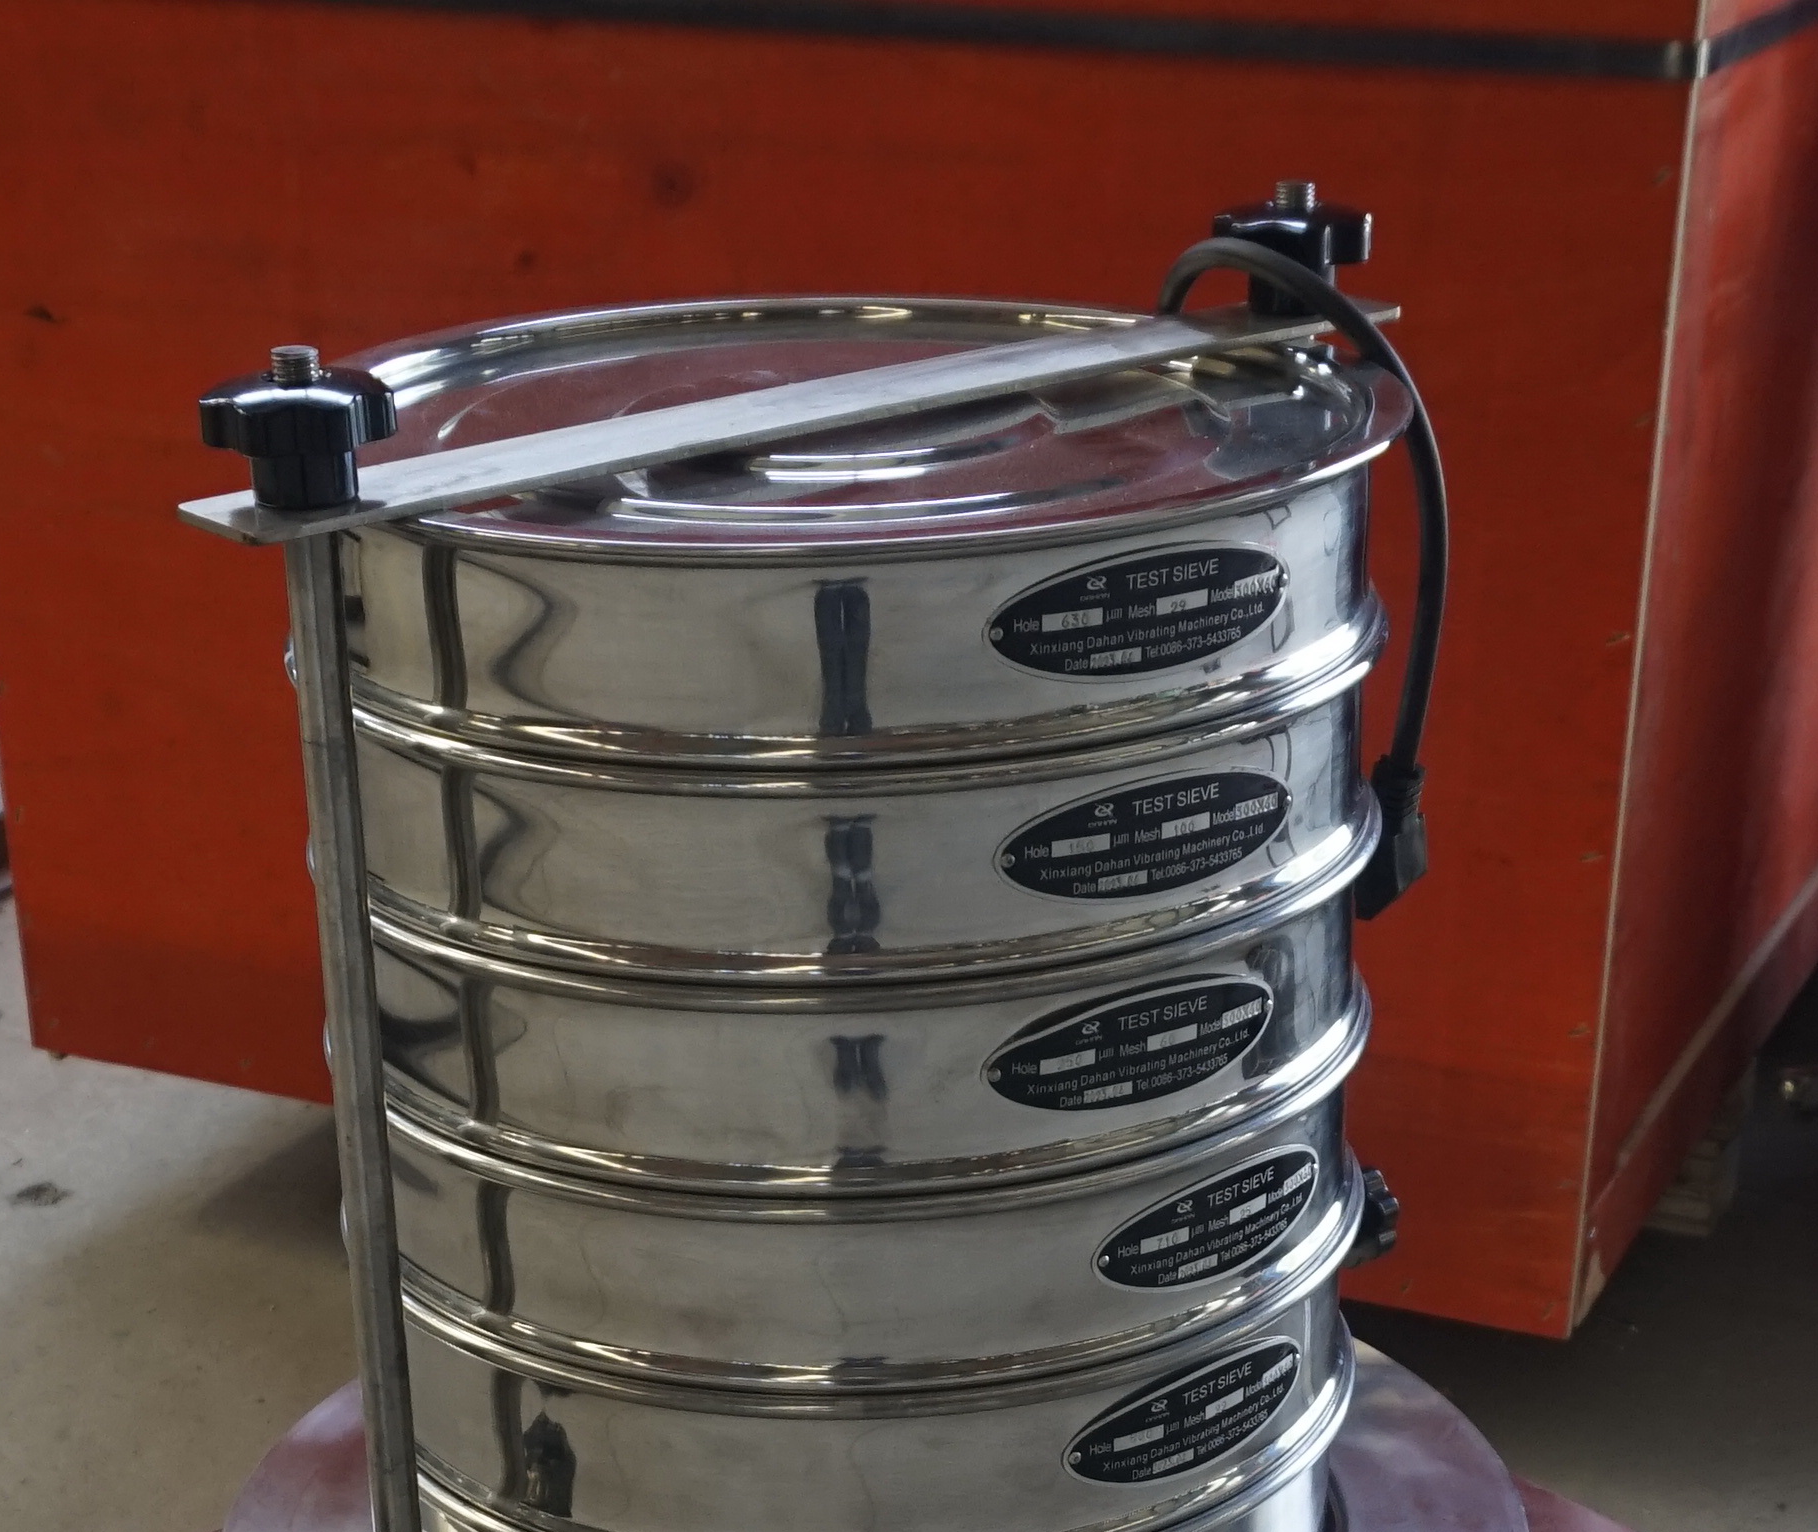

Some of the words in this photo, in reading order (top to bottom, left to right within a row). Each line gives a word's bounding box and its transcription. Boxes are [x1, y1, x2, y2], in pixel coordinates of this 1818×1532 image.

[1126, 569, 1168, 590] TEST
[1173, 558, 1219, 582] SIEVE
[1013, 618, 1039, 633] Hole
[1128, 604, 1156, 619] Mesh
[1211, 586, 1234, 603] Model
[1030, 637, 1084, 655] Xinxiang
[1087, 631, 1124, 649] Dahan
[1127, 622, 1176, 644] Vibrating
[1178, 613, 1229, 634] Machinery
[1065, 656, 1089, 671] Date
[1132, 795, 1171, 816] TEST
[1177, 782, 1219, 807] SIEVE
[1025, 845, 1049, 859] Hole
[1135, 829, 1161, 844] Mesh
[1213, 807, 1236, 824] Model
[1040, 863, 1092, 880] Xinxiang
[1095, 857, 1130, 873] Dahan
[1133, 848, 1180, 867] Vibrating
[1183, 837, 1231, 859] Machinery
[1073, 882, 1096, 895] Date
[1118, 1008, 1160, 1031] TEST
[1163, 995, 1208, 1020] SIEVE
[1011, 1061, 1037, 1075] Hole
[1119, 1042, 1146, 1057] Mesh
[1080, 1070, 1116, 1087] Dahan
[1119, 1059, 1166, 1078] Vibrating
[1060, 1095, 1082, 1108] Date
[1207, 1187, 1240, 1208] TEST
[1242, 1166, 1275, 1193] SIEVE
[1118, 1244, 1139, 1258] Hole
[1208, 1216, 1229, 1232] Mesh
[1176, 1246, 1205, 1261] Dahan
[1207, 1232, 1243, 1251] Vibrating
[1158, 1271, 1177, 1284] Date
[1183, 1383, 1215, 1405] TEST
[1218, 1362, 1252, 1389] SIEVE
